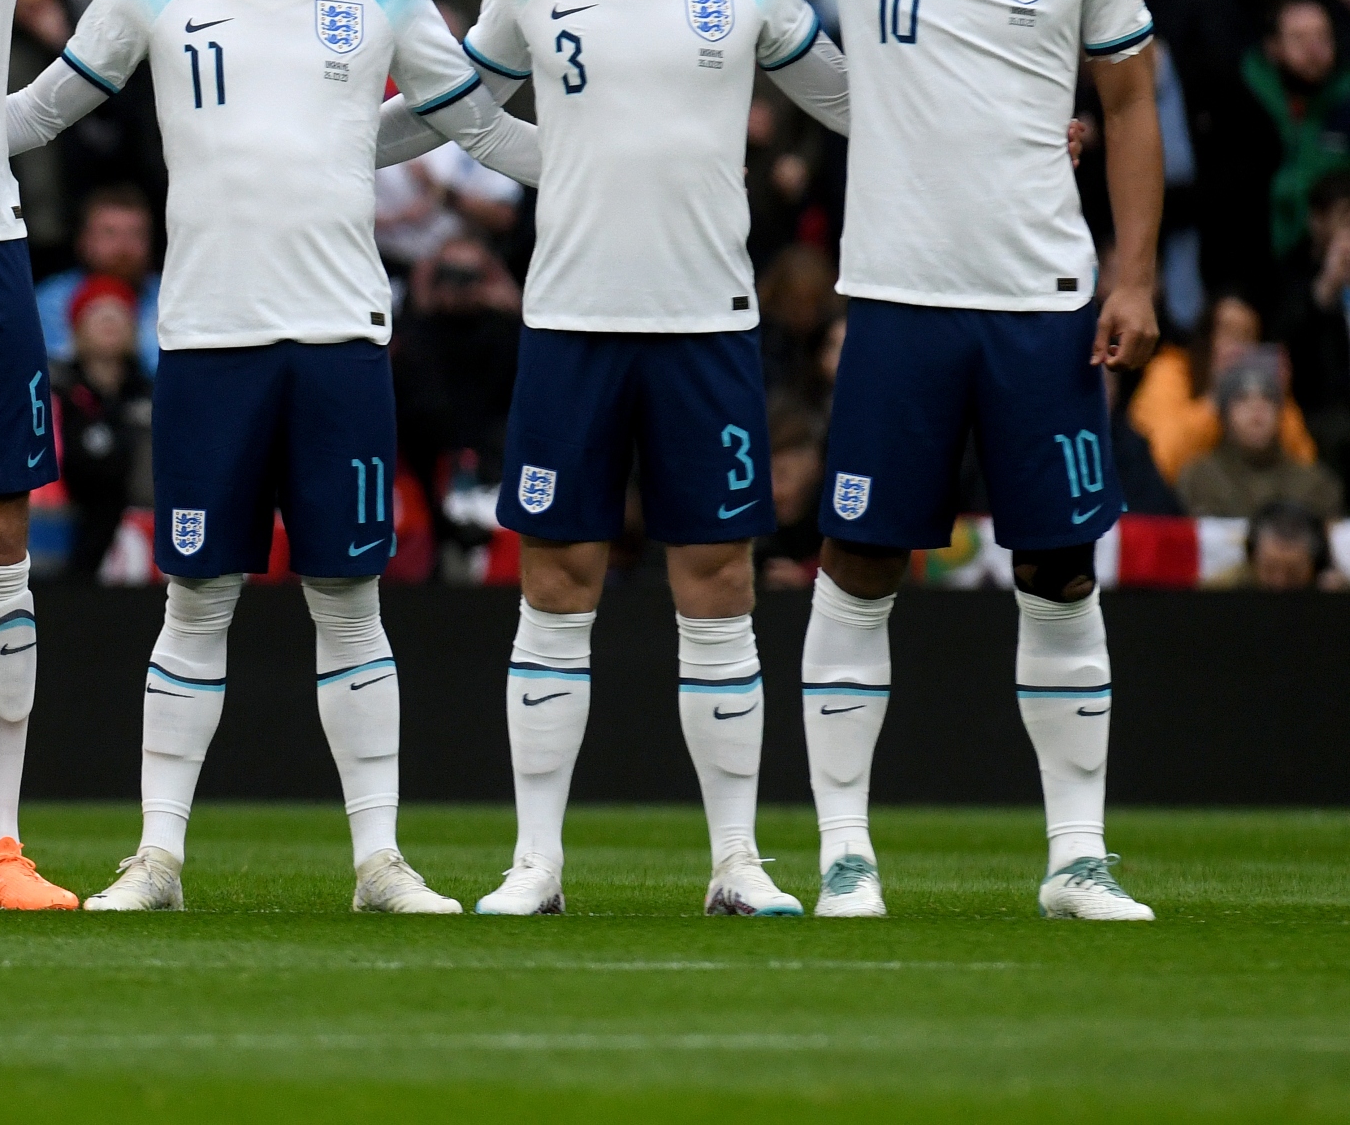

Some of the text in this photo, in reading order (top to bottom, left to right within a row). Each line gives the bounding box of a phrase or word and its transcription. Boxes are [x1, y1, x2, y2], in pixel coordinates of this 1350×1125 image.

[184, 41, 226, 109] 11
[556, 29, 587, 95] 3
[29, 370, 46, 436] 6
[351, 456, 385, 524] 11
[721, 424, 754, 491] 3
[1055, 429, 1103, 498] 10
